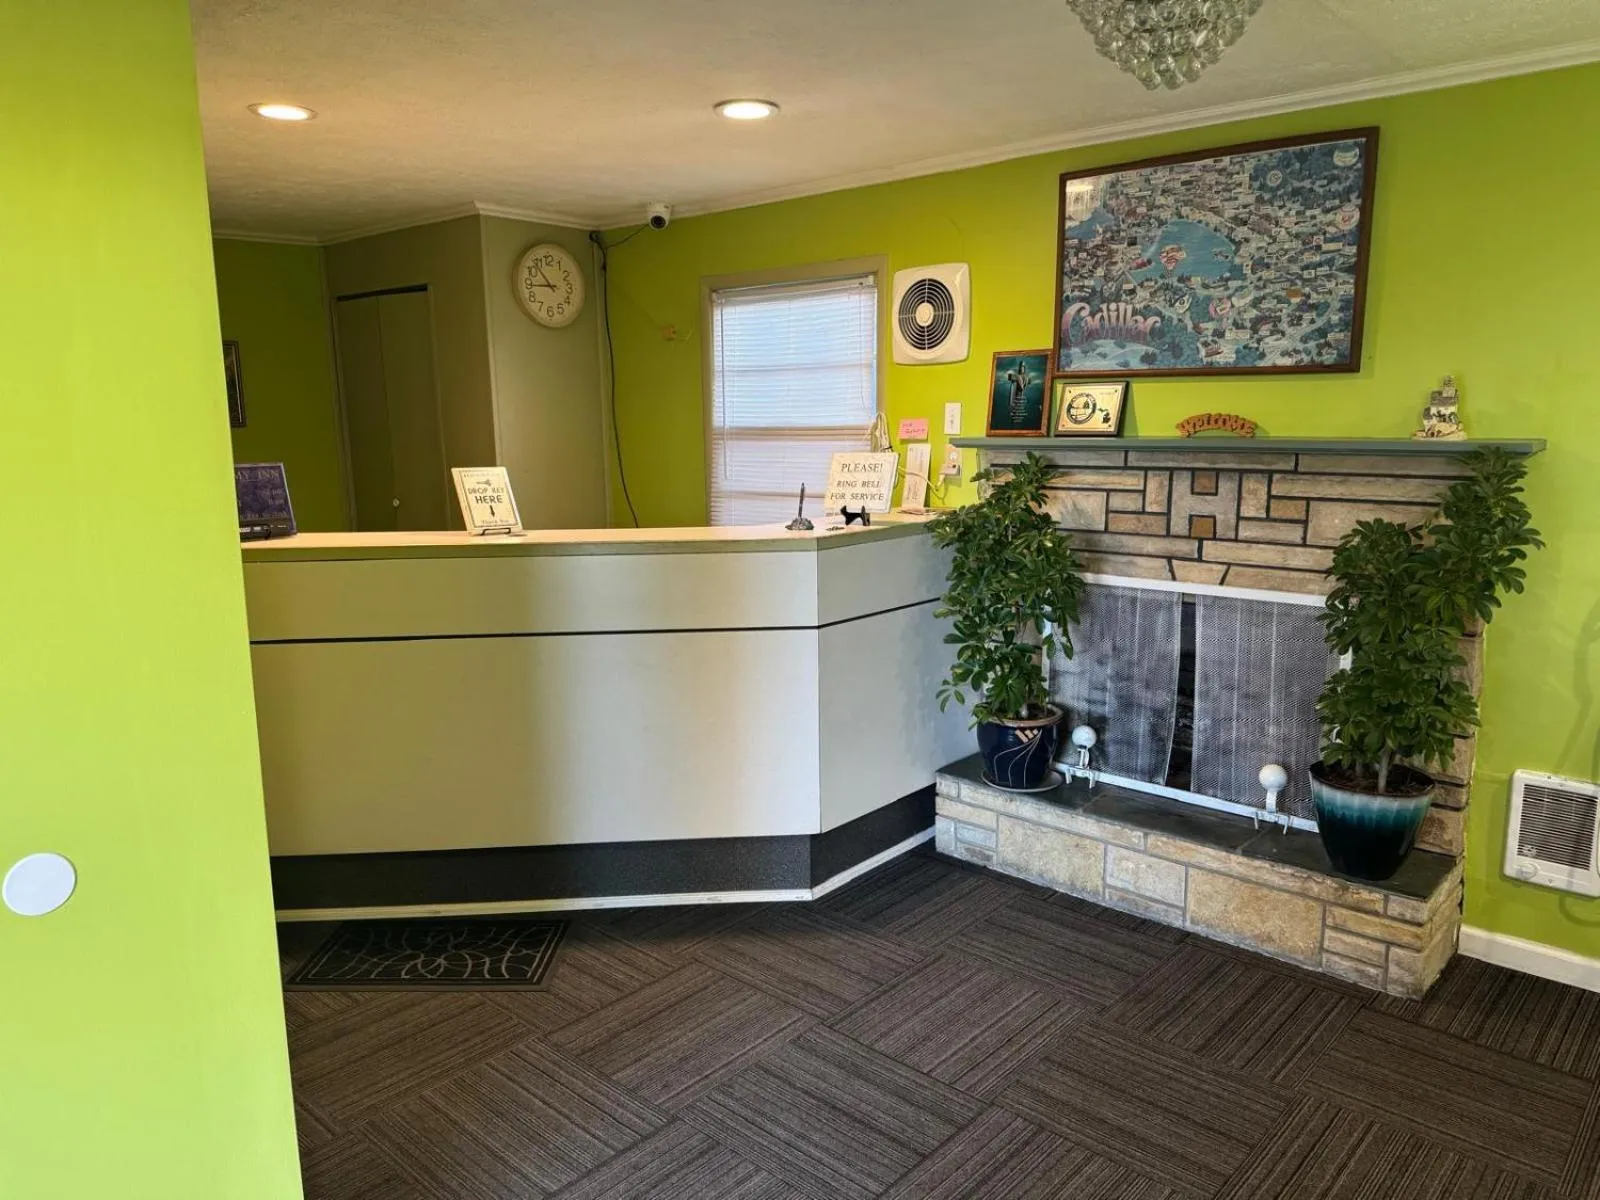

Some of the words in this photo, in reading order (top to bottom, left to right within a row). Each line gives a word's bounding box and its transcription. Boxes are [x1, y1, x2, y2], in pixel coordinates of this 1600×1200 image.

[543, 254, 554, 267] 12
[527, 265, 538, 278] 10
[562, 270, 570, 281] 2
[524, 277, 533, 290] 9
[565, 282, 573, 295] 3
[528, 291, 536, 303] 8
[564, 295, 571, 305] 4
[537, 301, 544, 312] 7
[546, 306, 555, 318] 6
[556, 303, 565, 315] 5
[1061, 302, 1161, 351] Cadillac
[841, 463, 884, 473] PLEASE!
[836, 480, 857, 488] RING
[474, 494, 503, 504] HERE
[830, 492, 846, 500] FOR
[849, 492, 885, 500] SERVICE
